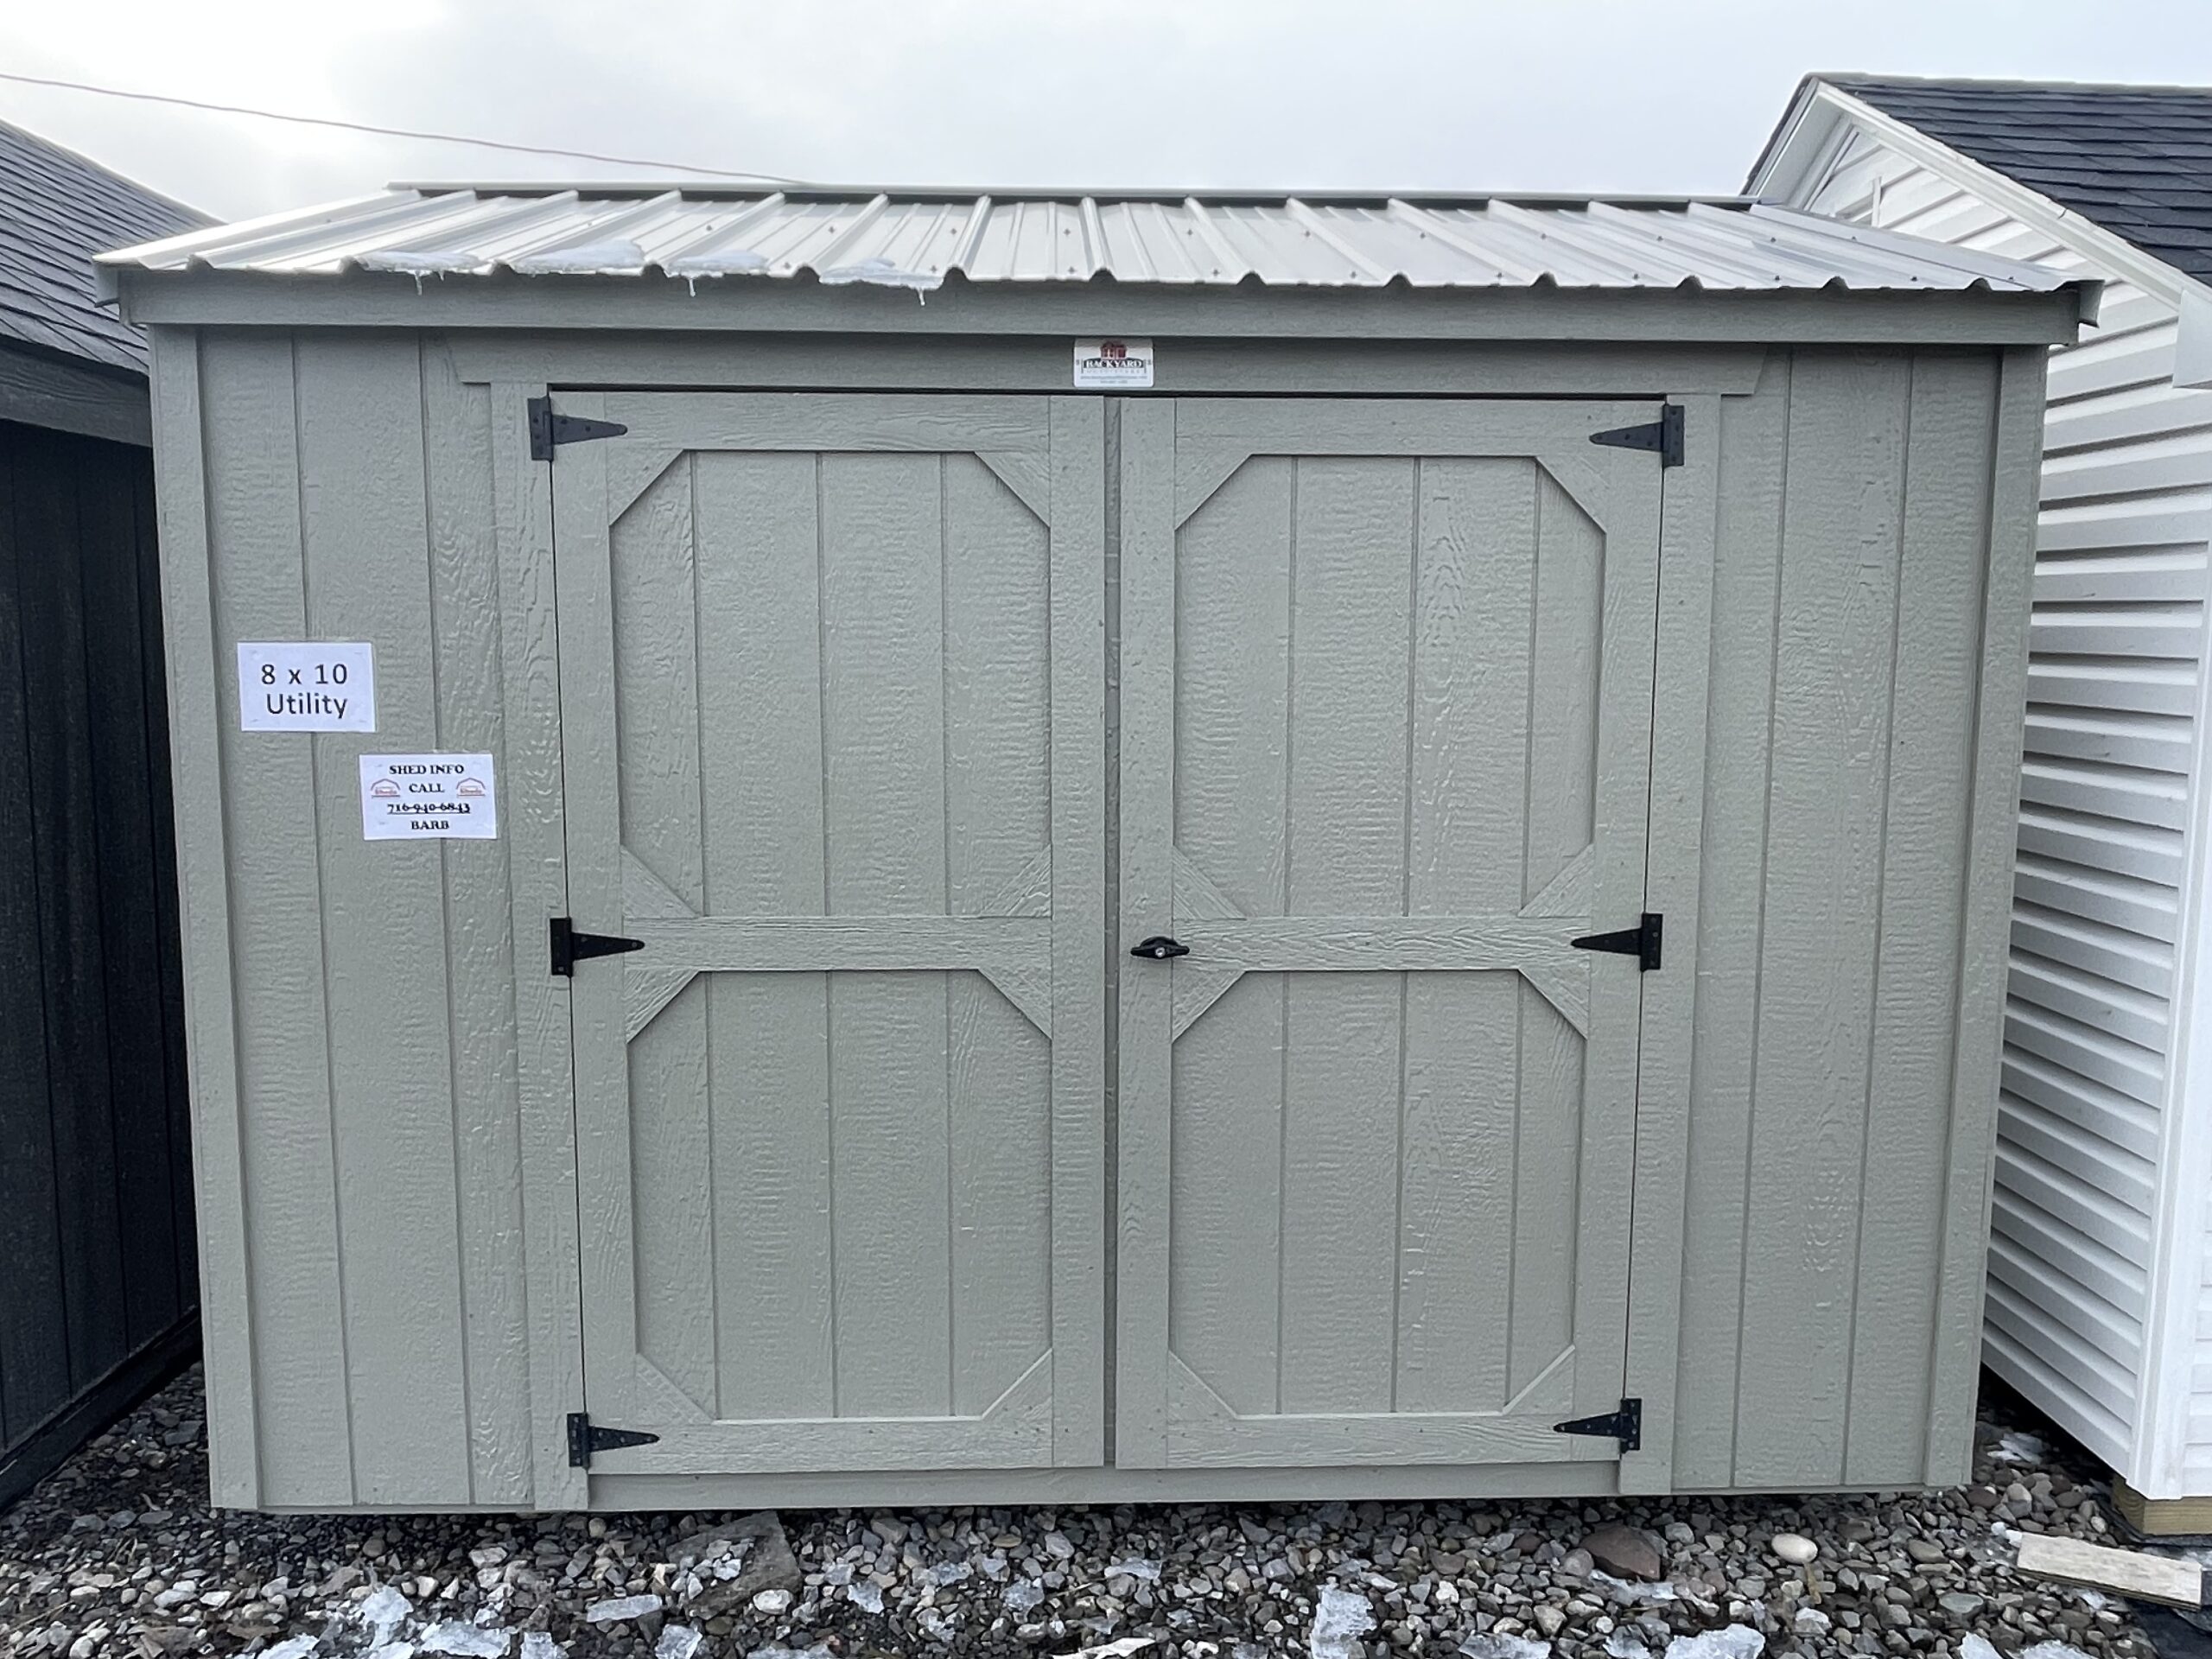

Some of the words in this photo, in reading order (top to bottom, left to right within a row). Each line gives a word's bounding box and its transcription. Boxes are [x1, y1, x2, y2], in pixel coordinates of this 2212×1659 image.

[261, 664, 276, 685] 8
[288, 669, 302, 685] x
[315, 664, 347, 685] 10
[266, 692, 347, 719] Utility
[389, 765, 427, 775] SHED
[429, 764, 465, 774] INFO
[408, 783, 445, 793] CALL
[387, 803, 471, 814] 716-940-6843
[410, 820, 450, 830] BARB
